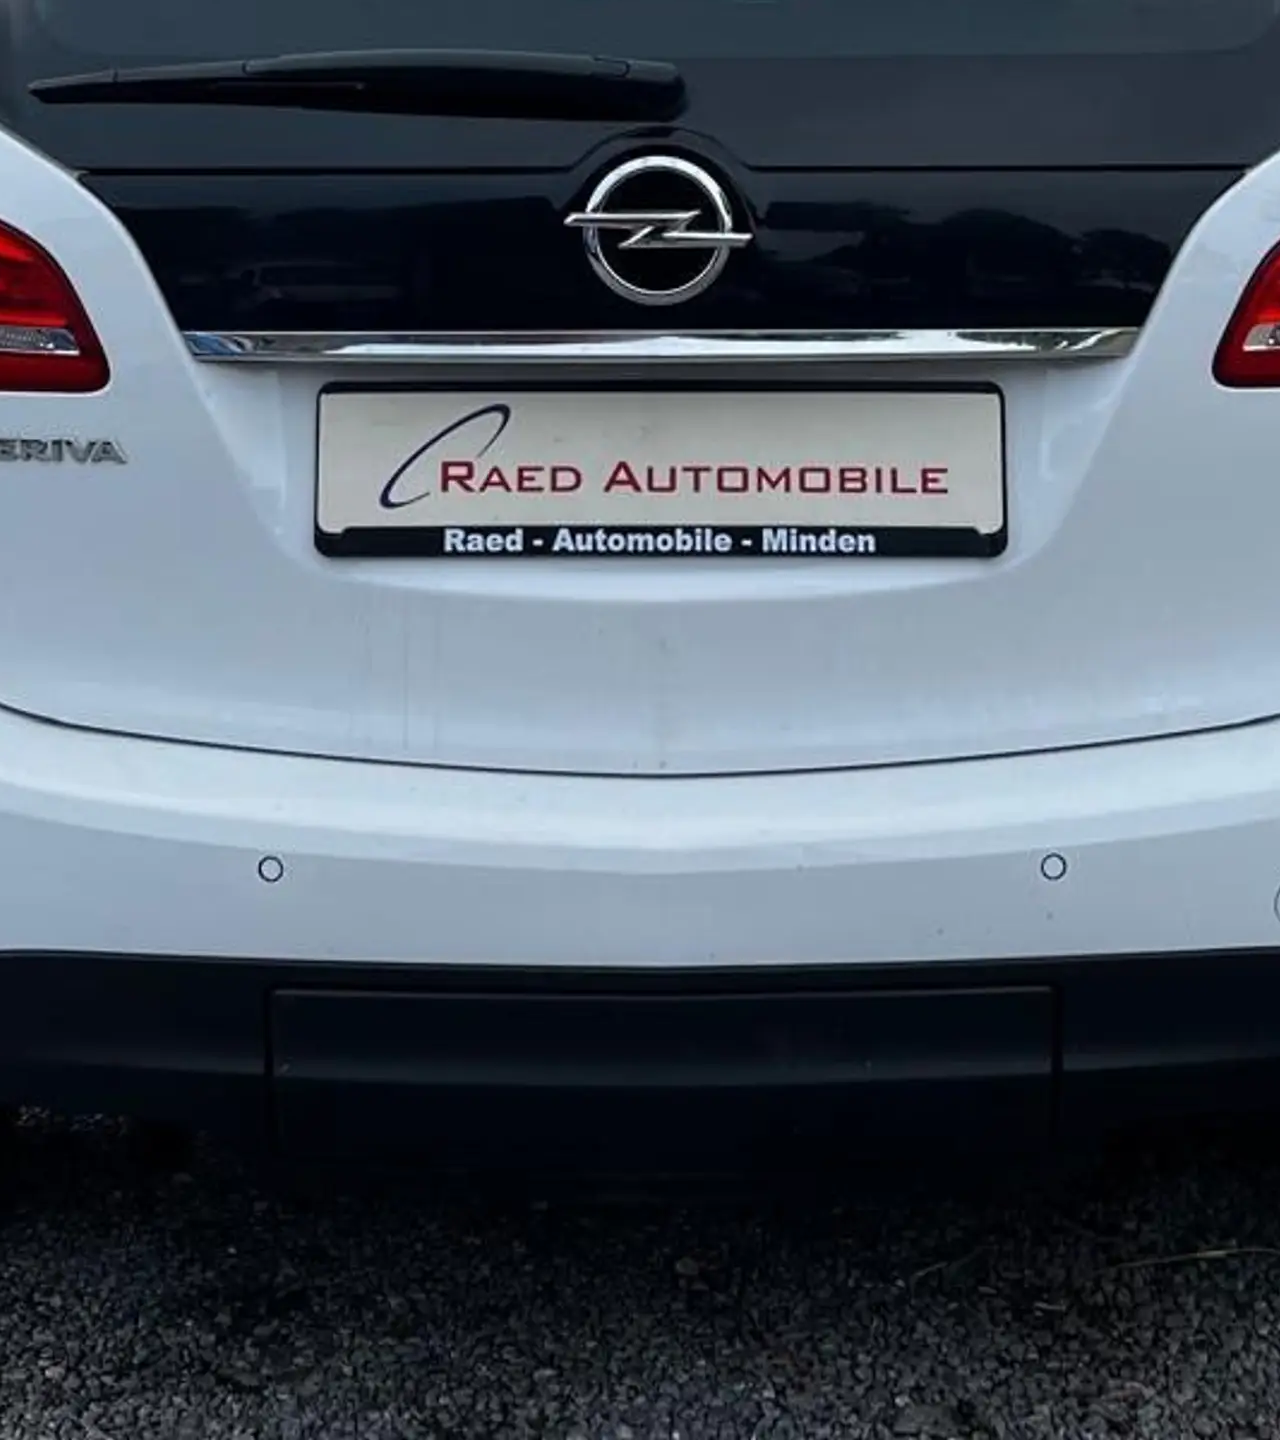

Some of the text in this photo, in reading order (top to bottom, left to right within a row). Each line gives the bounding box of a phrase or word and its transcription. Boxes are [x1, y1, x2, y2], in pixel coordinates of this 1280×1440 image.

[440, 461, 949, 494] RAED AUTOMOBILE
[443, 528, 523, 553] Raed
[552, 528, 733, 553] Automobile
[762, 528, 877, 554] Minden
